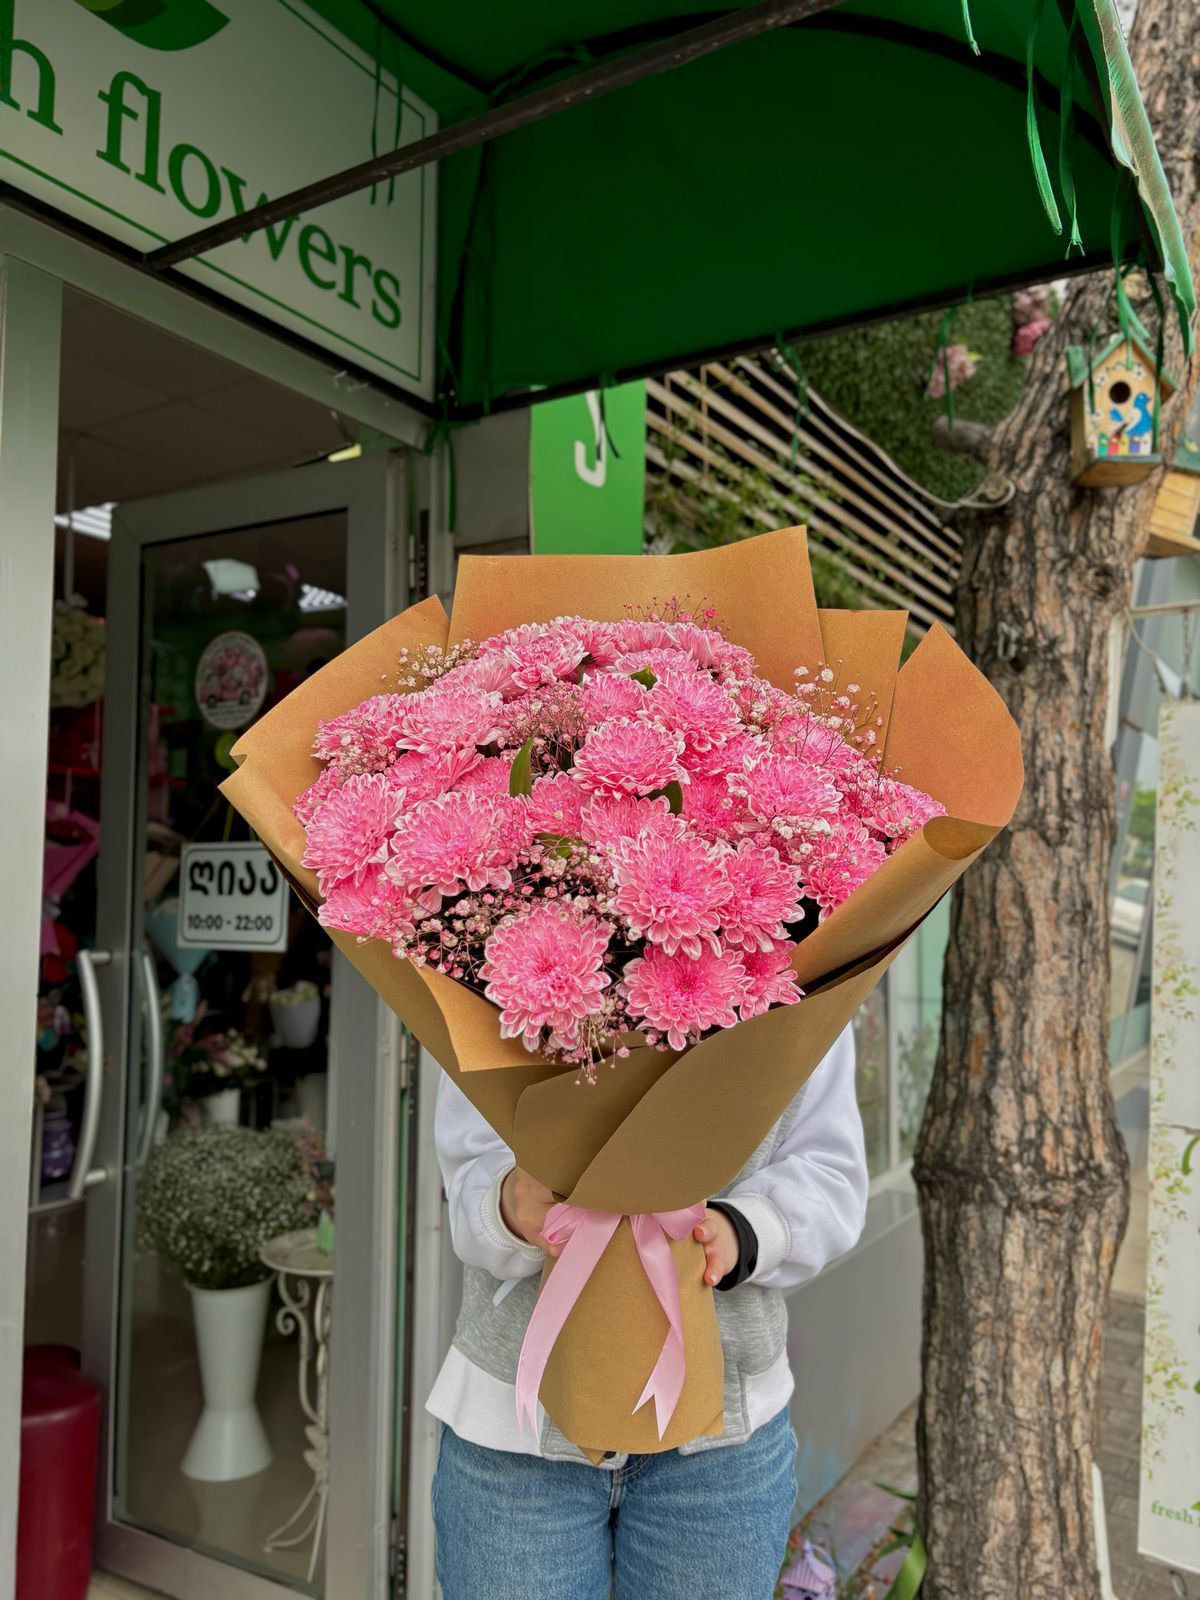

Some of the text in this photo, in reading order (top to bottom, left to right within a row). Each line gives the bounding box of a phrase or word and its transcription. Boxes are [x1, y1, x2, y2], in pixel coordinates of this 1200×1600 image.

[189, 860, 279, 896] ღიაა
[187, 913, 222, 931] 10:00
[234, 914, 273, 932] 22:00
[1151, 1500, 1193, 1525] fresh
